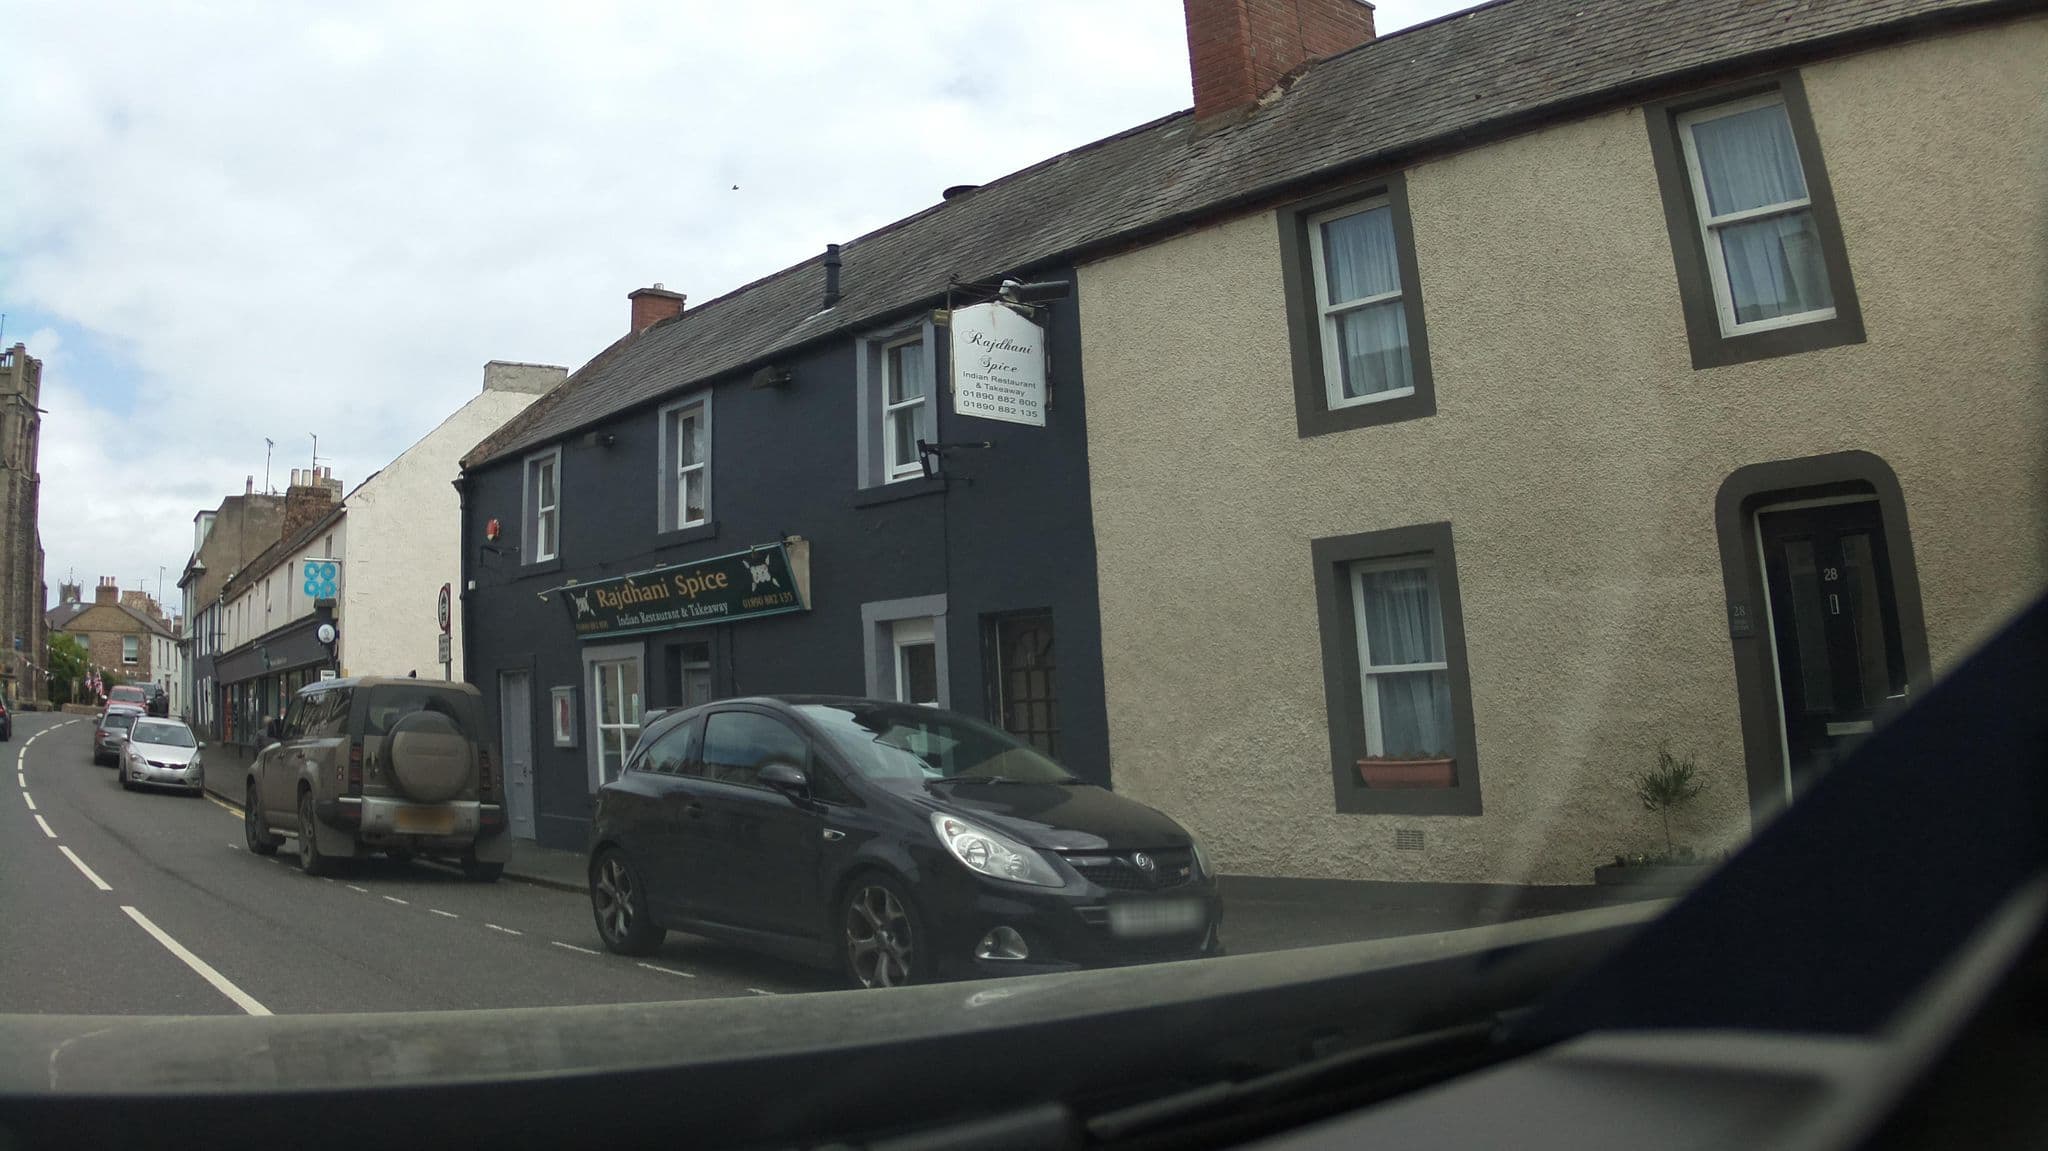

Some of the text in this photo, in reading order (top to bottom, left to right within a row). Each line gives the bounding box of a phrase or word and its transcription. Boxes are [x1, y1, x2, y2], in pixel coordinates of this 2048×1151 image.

[963, 330, 1033, 354] Rajdhani
[979, 355, 1018, 374] Spice
[963, 371, 1036, 389] Indian Restaurant
[963, 389, 1037, 407] 01890 882 800
[985, 383, 1026, 397] Takeaway
[963, 400, 1038, 418] 01890 882 135
[1824, 568, 1838, 581] 28
[596, 570, 729, 610] Rajdhani Spice
[616, 611, 640, 627] Indian
[640, 606, 680, 624] Restaurant
[681, 606, 689, 617] &
[689, 601, 729, 618] Takeaway
[1733, 605, 1746, 617] 28
